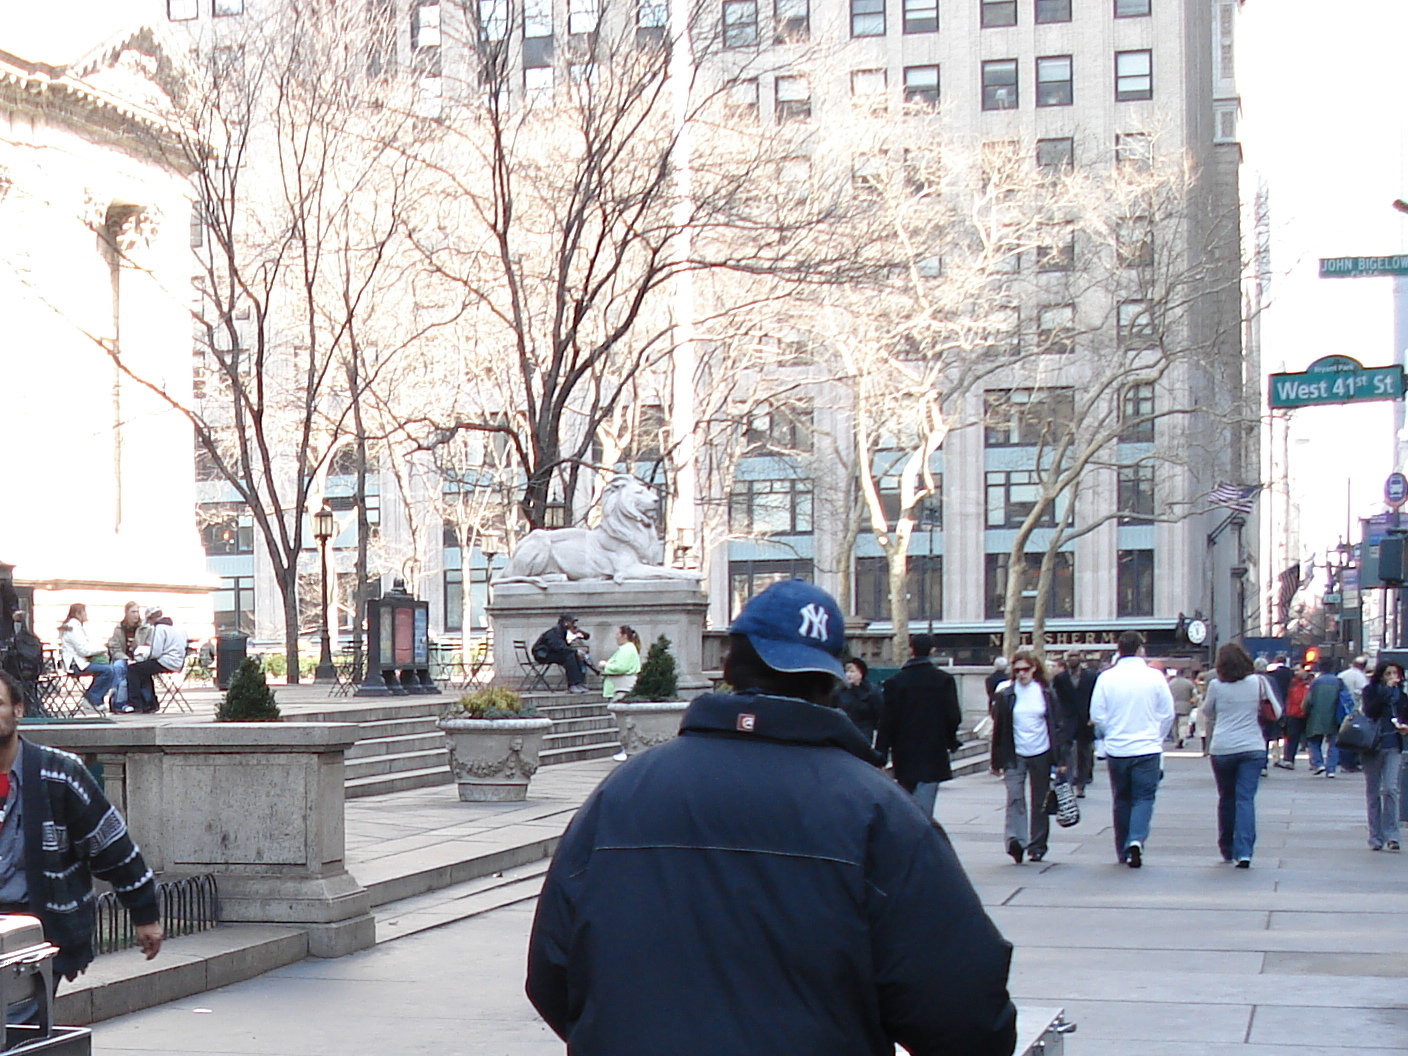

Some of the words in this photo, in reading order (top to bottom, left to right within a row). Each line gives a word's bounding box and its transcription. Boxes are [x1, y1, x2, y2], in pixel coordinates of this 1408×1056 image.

[1321, 258, 1352, 272] JOHN
[1358, 256, 1408, 271] BIGELOW
[1338, 363, 1355, 371] Park
[1277, 380, 1328, 401] West
[1332, 374, 1368, 396] 41st
[1373, 373, 1395, 394] St
[798, 602, 829, 643] NY
[989, 633, 1031, 647] NT
[1044, 631, 1149, 645] SHERMN
